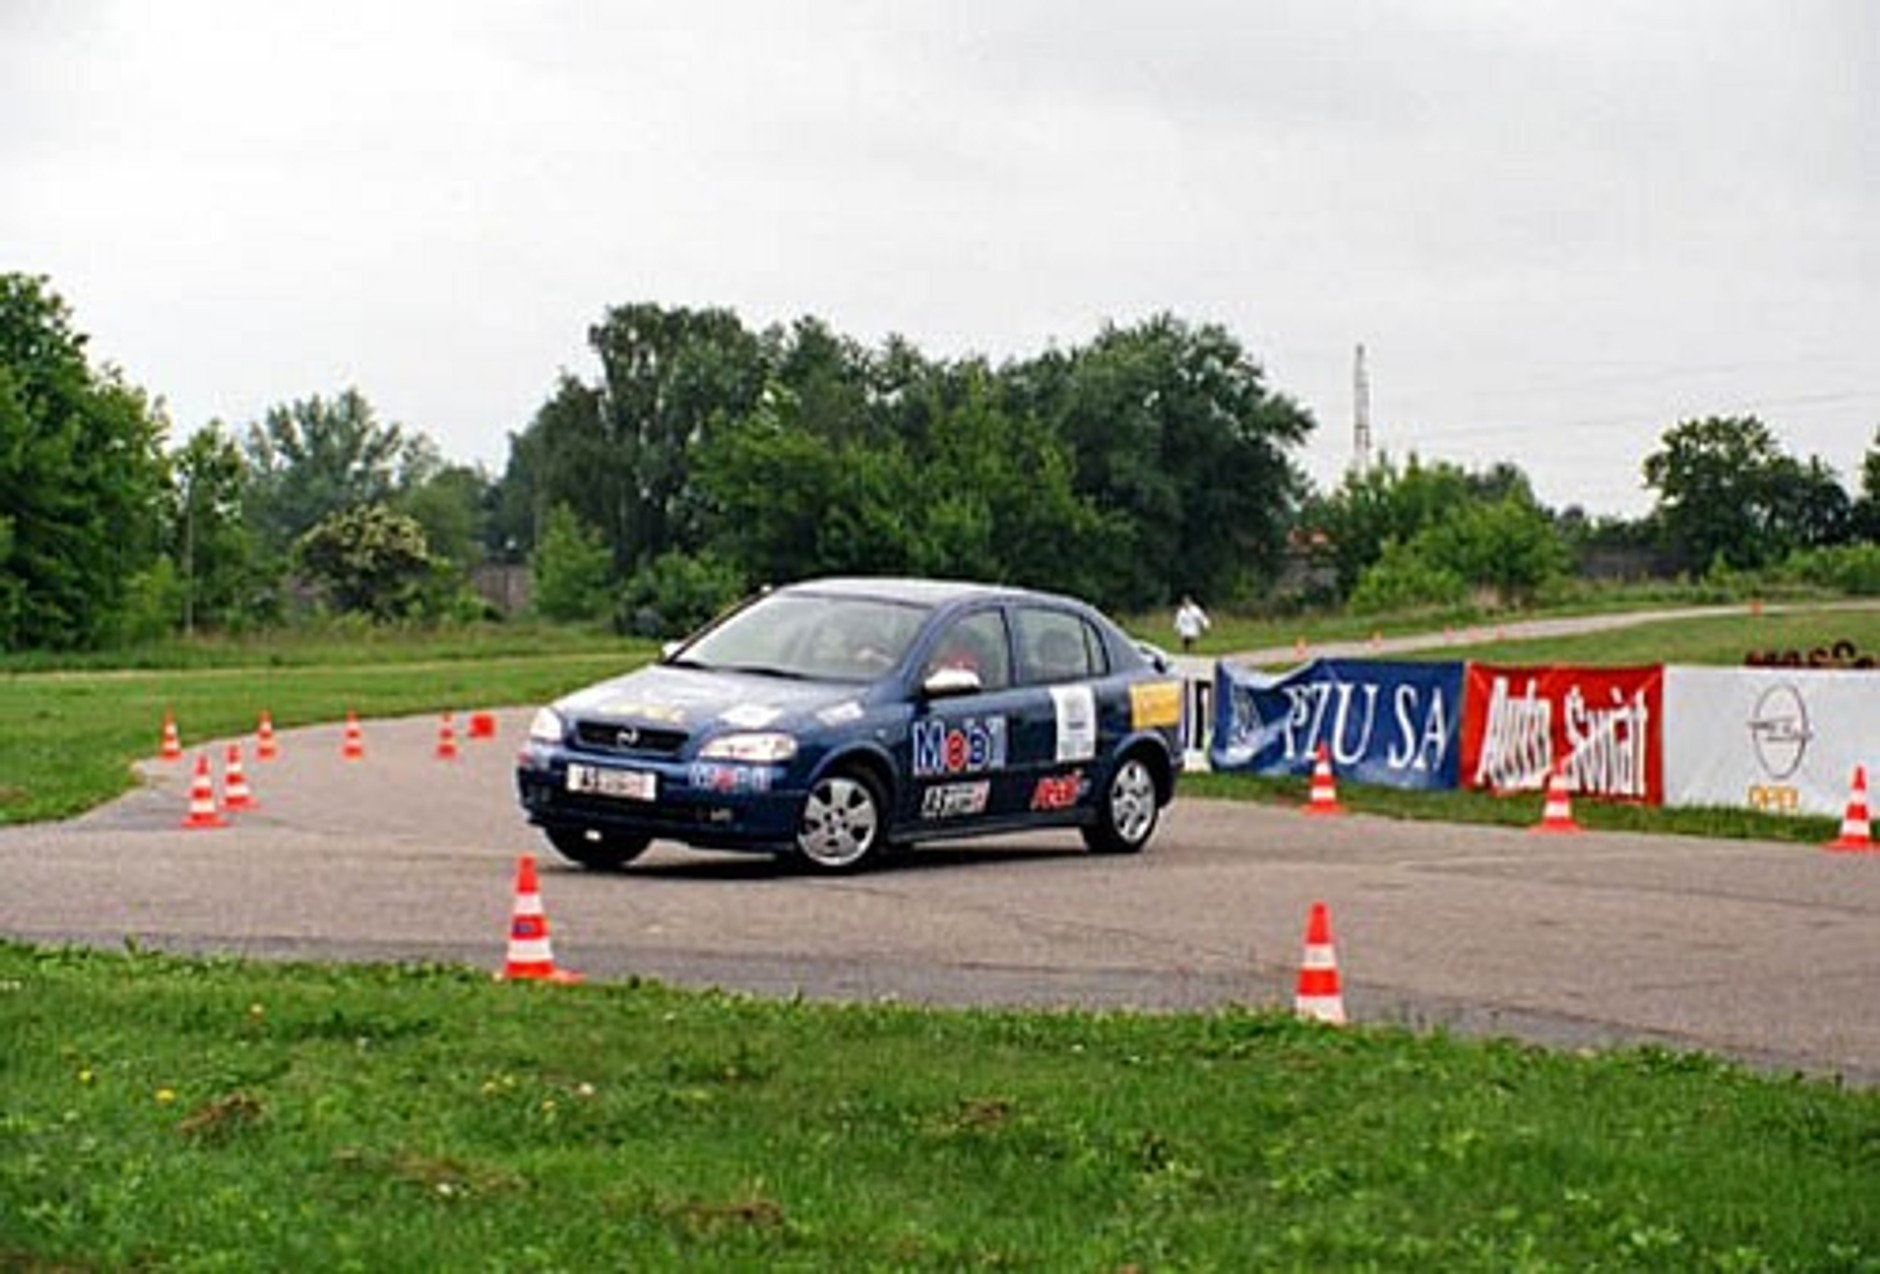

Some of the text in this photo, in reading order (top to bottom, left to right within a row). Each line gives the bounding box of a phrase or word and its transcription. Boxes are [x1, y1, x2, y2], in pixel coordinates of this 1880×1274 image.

[1283, 682, 1380, 765] PZU
[1387, 683, 1449, 772] SA
[1474, 675, 1554, 791] Auto
